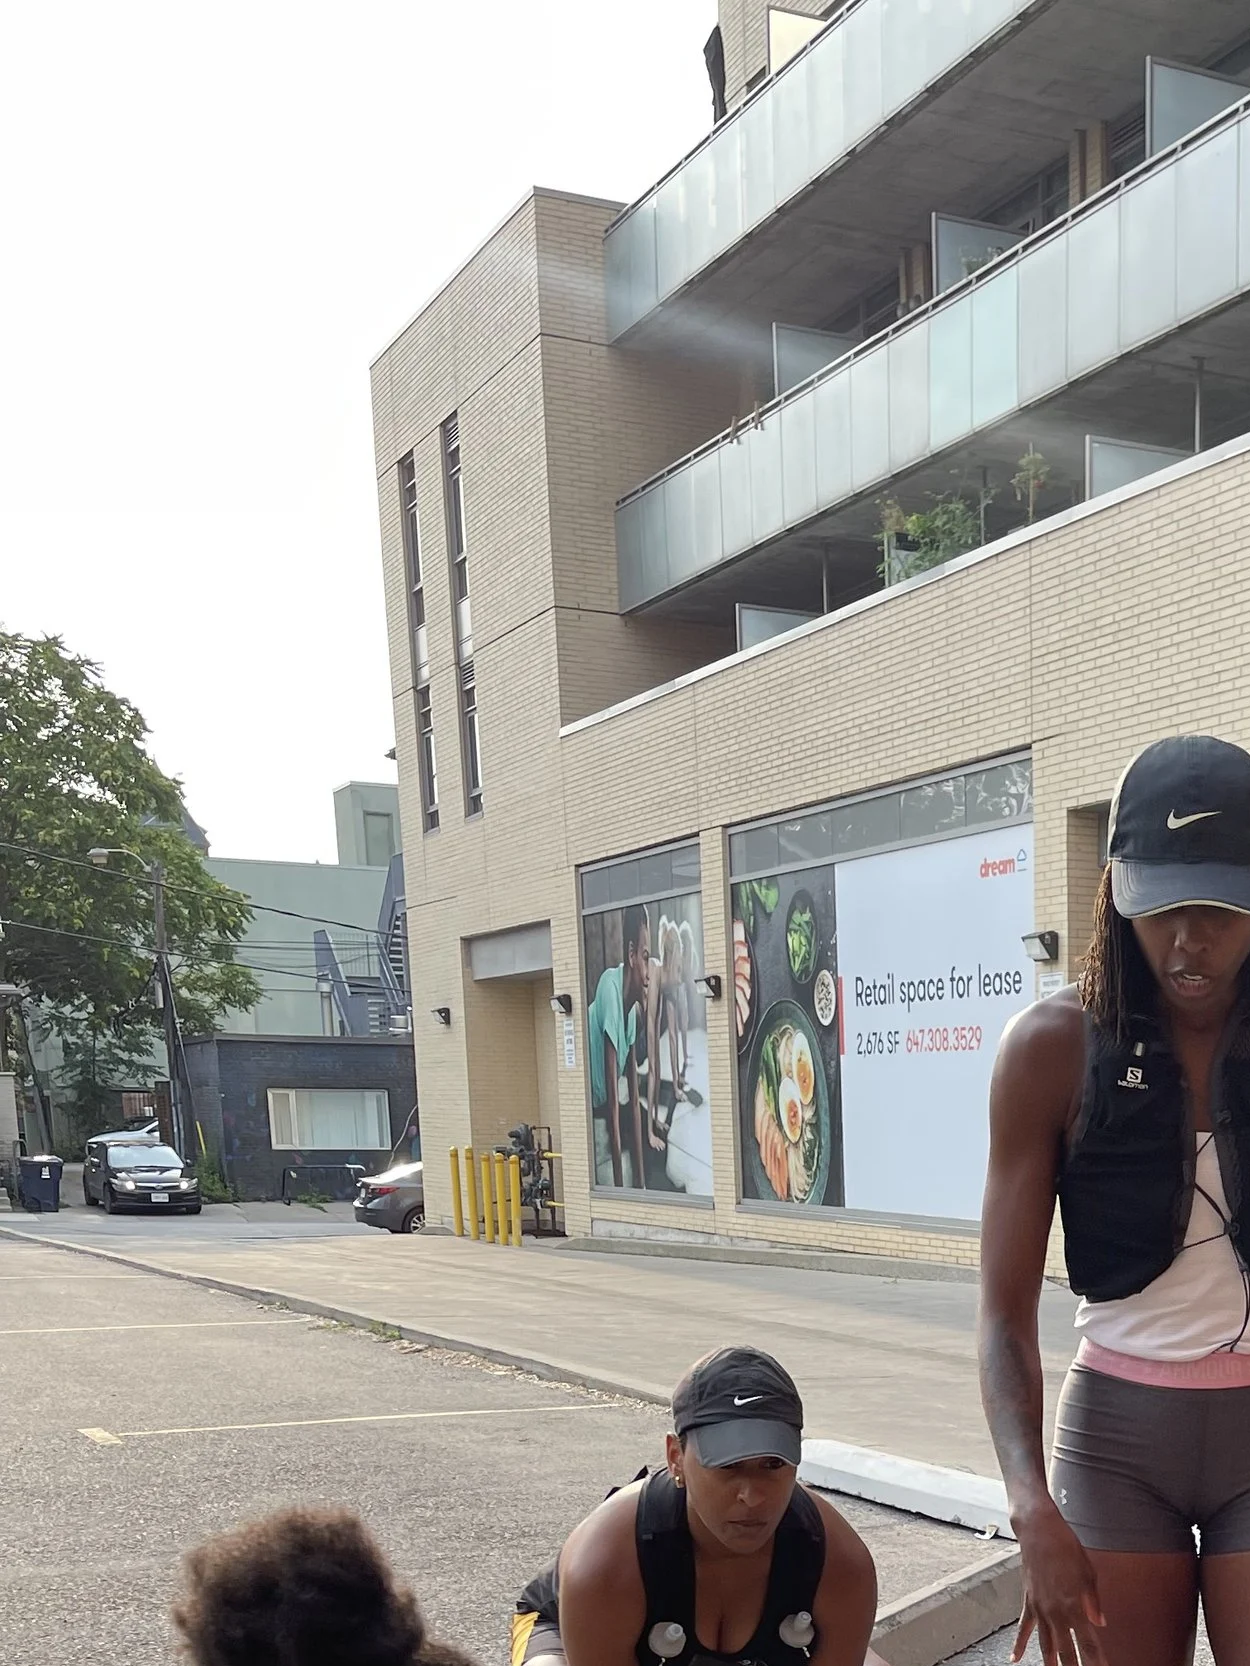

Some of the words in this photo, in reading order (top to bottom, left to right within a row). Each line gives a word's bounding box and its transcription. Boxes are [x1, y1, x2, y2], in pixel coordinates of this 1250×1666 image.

[980, 857, 1015, 878] dream
[855, 973, 895, 1007] Retail
[900, 976, 945, 1013] space
[950, 966, 973, 999] for
[978, 963, 1022, 997] lease
[857, 1031, 884, 1057] 2,676
[887, 1031, 900, 1054] SF
[906, 1025, 983, 1053] 647.308.3529
